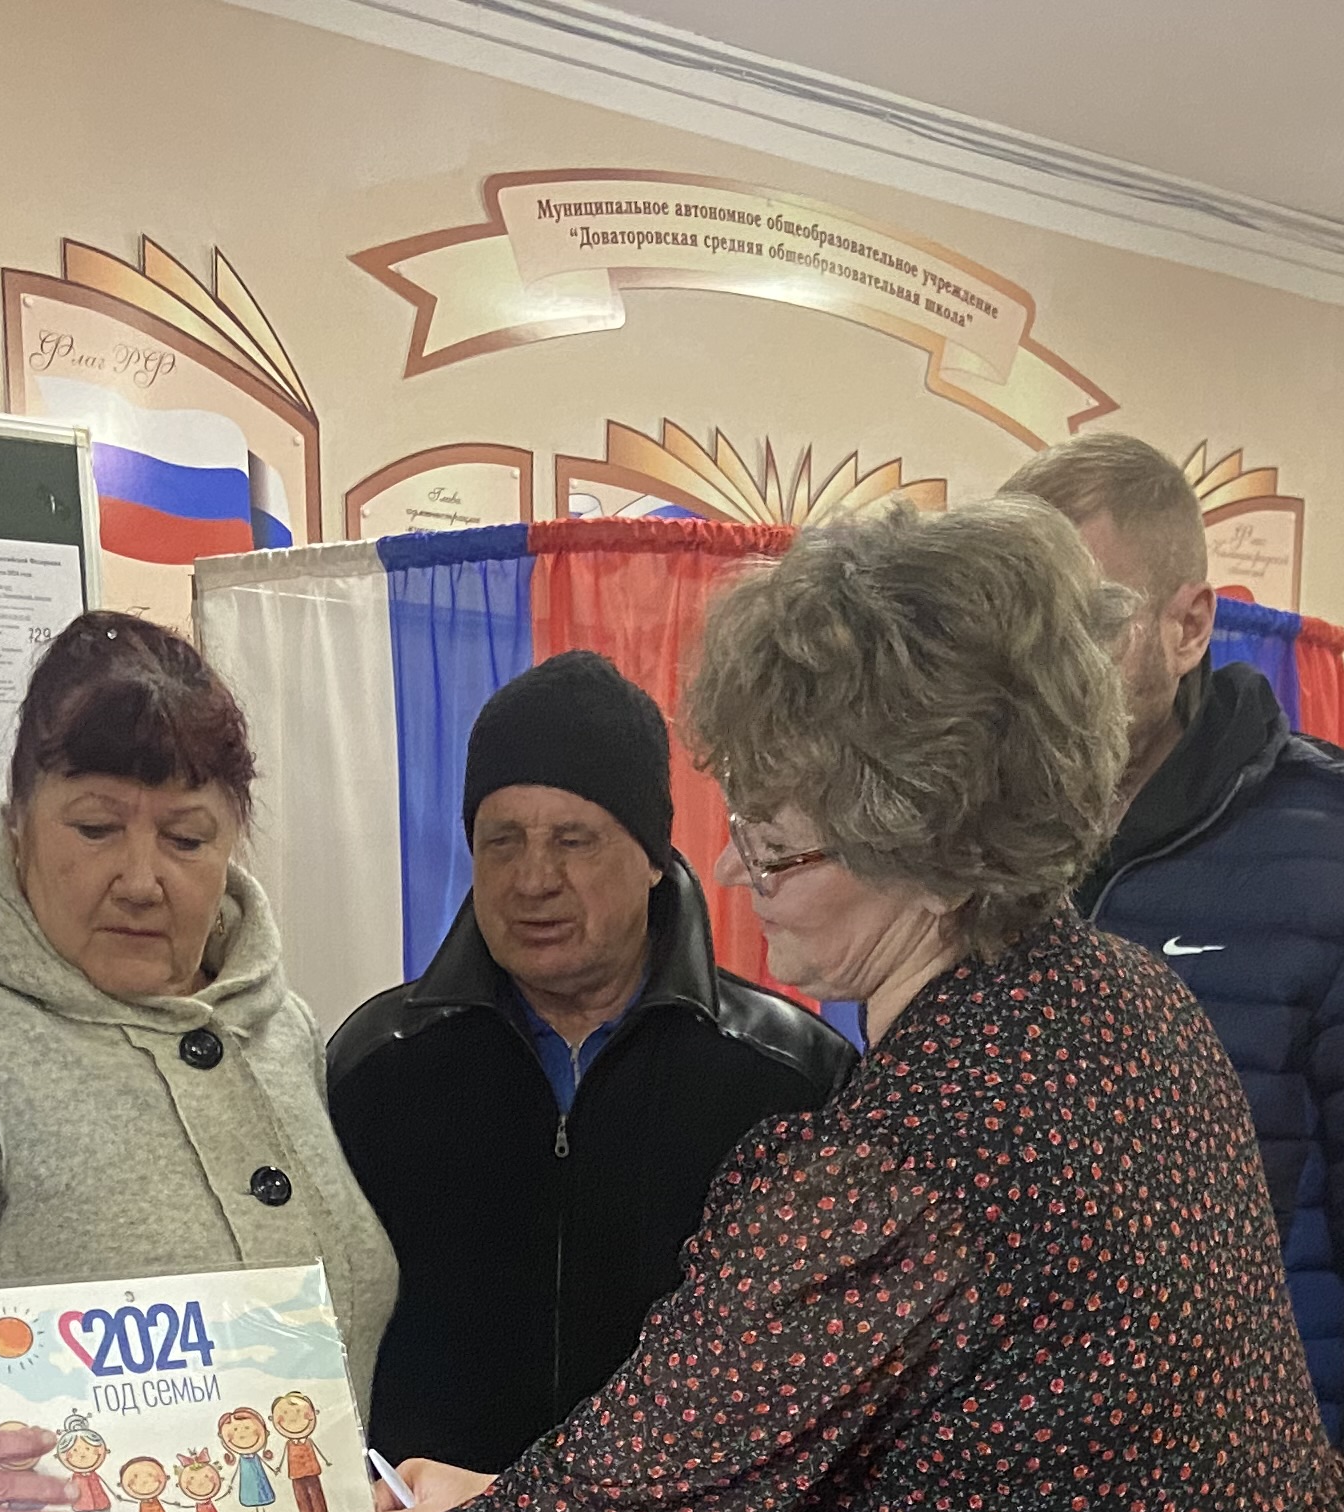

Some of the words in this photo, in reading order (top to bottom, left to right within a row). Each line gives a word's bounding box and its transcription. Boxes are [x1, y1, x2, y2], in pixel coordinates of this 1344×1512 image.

[537, 199, 669, 223] Муниципальное
[675, 201, 762, 228] автономное
[767, 214, 919, 277] общеобразовательное
[922, 268, 1000, 320] учреждение
[703, 233, 764, 258] средняя
[769, 243, 921, 306] общеобразовательная
[29, 329, 106, 371] Флаг
[81, 1300, 216, 1377] 2024
